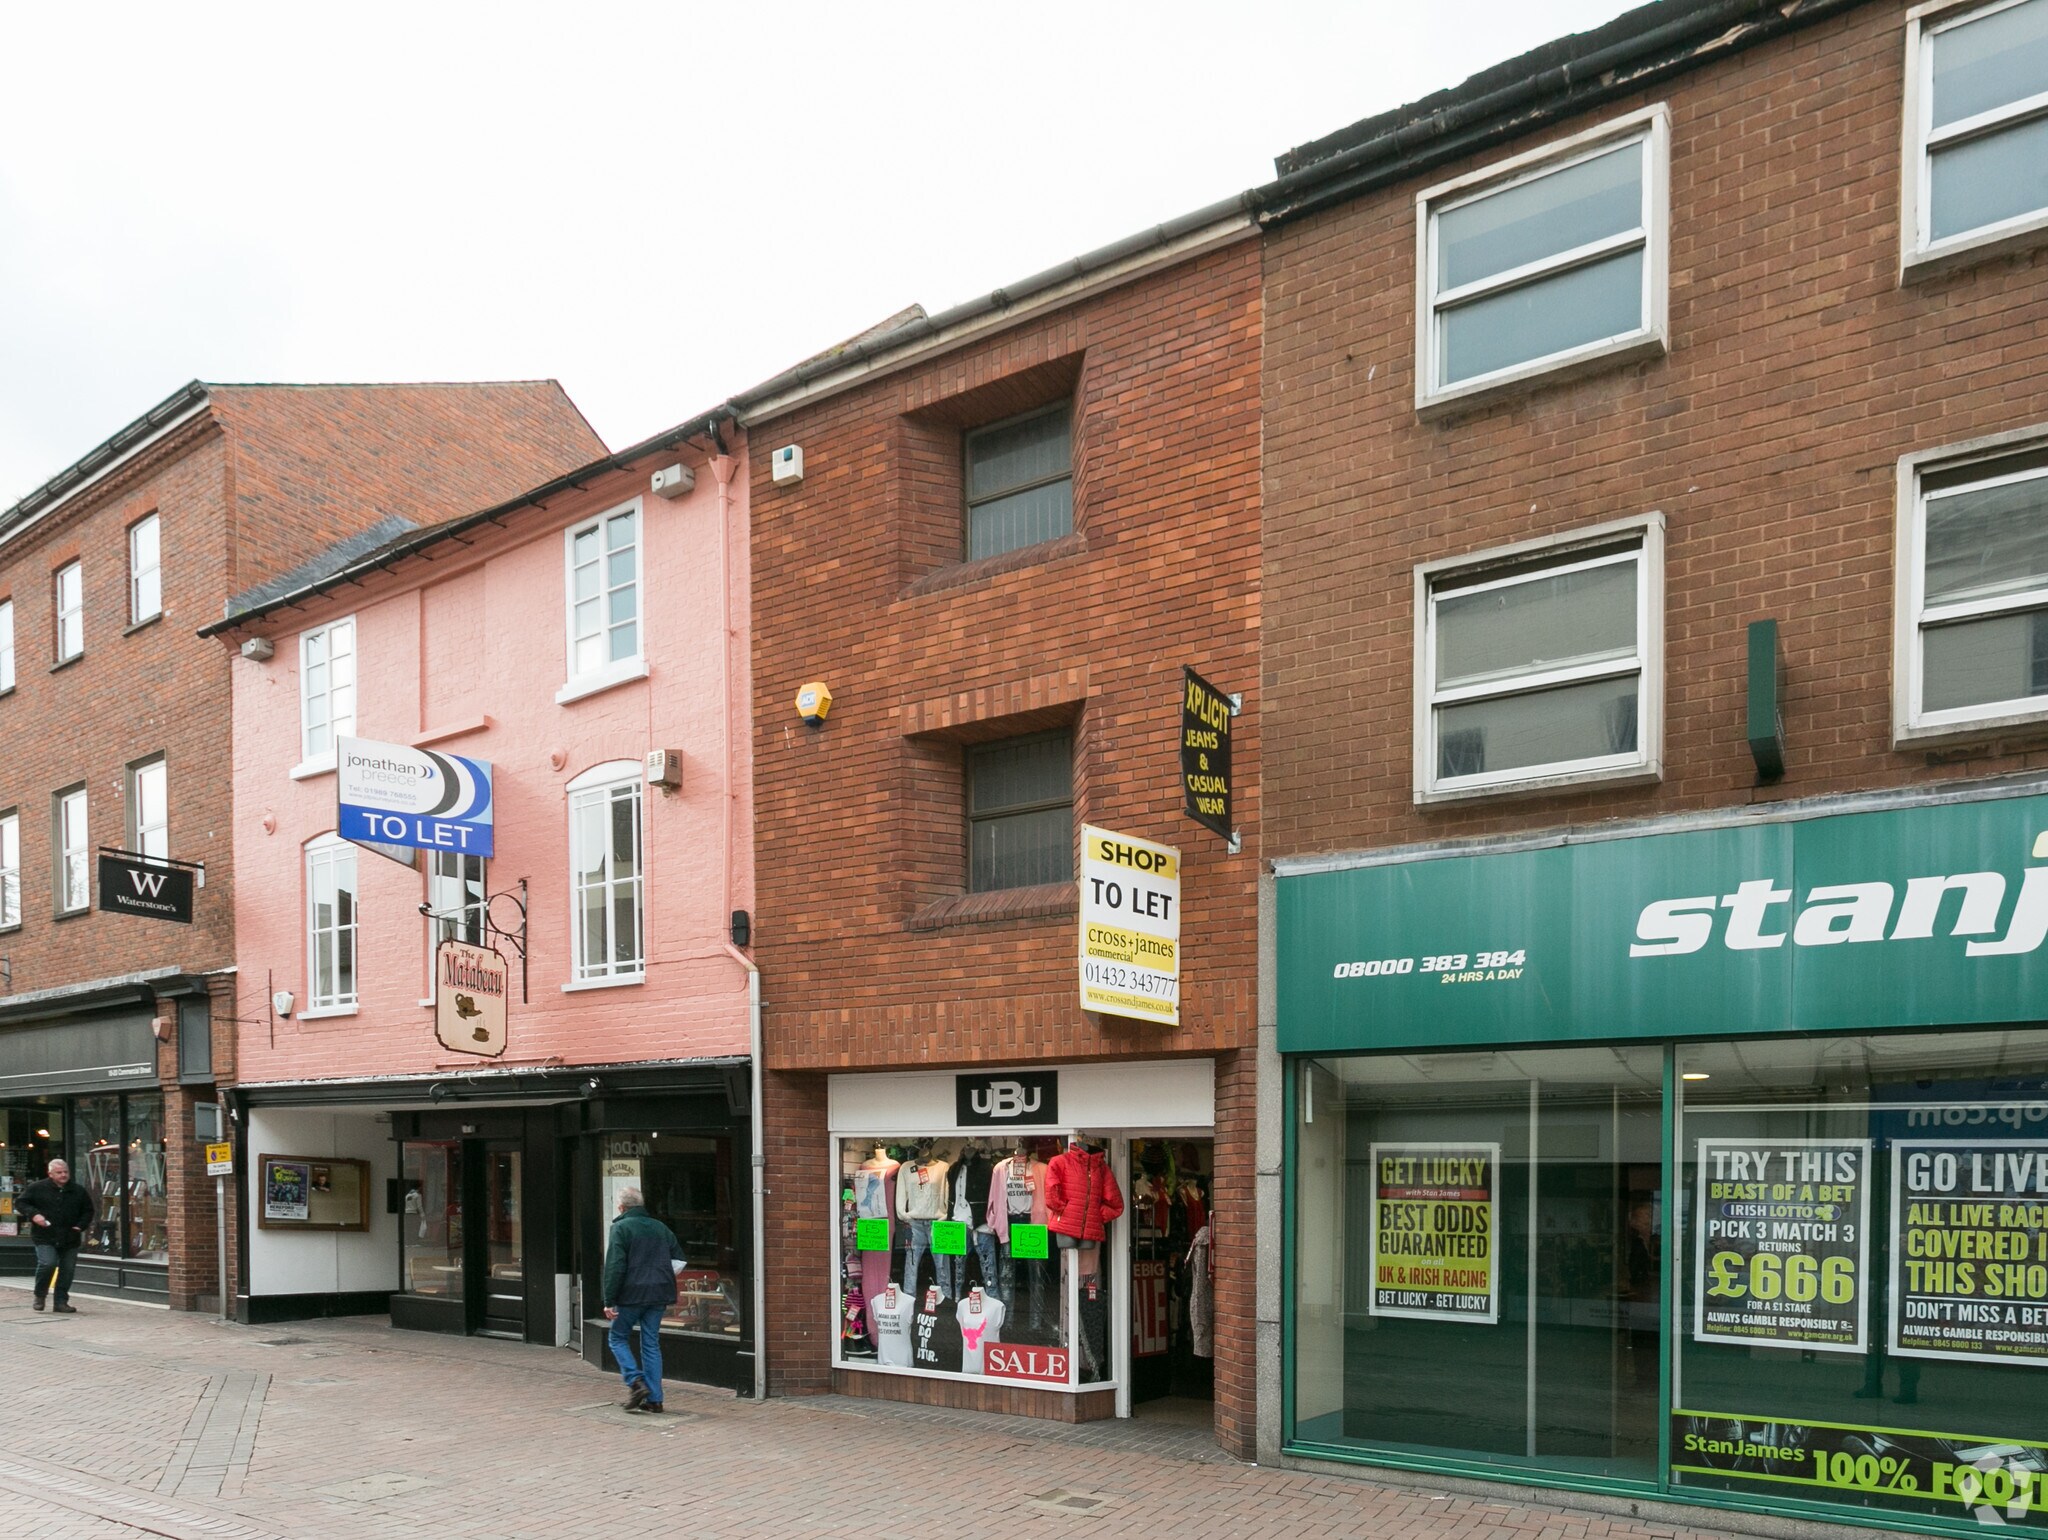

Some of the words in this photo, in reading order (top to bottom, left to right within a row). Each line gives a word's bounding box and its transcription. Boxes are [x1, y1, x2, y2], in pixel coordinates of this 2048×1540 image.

[1186, 679, 1229, 735] XPLICIT
[1185, 729, 1218, 750] JEANS
[347, 752, 416, 775] jonathan
[1199, 753, 1209, 771] &
[361, 769, 417, 787] preece
[1187, 774, 1228, 794] CASUAL
[1196, 797, 1225, 815] WEAR
[361, 812, 407, 839] TO
[417, 820, 473, 848] LET
[1101, 840, 1167, 873] SHOP
[127, 869, 168, 898] W
[116, 895, 177, 912] Waterstone's
[1091, 877, 1122, 909] TO
[1132, 887, 1172, 920] LET
[460, 949, 475, 960] The
[1088, 947, 1133, 963] commercial
[1333, 958, 1414, 978] 08000
[1419, 954, 1468, 972] 383
[1473, 950, 1526, 968] 384
[443, 952, 503, 998] Matabeau
[1085, 962, 1126, 988] 01432
[1129, 970, 1176, 997] 343777
[1441, 973, 1456, 984] 24
[1458, 971, 1484, 982] HRS
[1485, 971, 1495, 981] A
[1497, 969, 1523, 980] DAY
[1087, 989, 1174, 1014] www.crossandjames.co.uk
[970, 1081, 1042, 1117] UBU
[1381, 1157, 1417, 1185] GET
[1422, 1157, 1487, 1186] LUCKY
[1711, 1151, 1771, 1181] TRY
[1780, 1152, 1856, 1183] THIS
[1908, 1153, 1957, 1192] GO
[1972, 1153, 2048, 1193] LIVE
[1422, 1189, 1438, 1197] Stan
[1711, 1183, 1768, 1200] BEAST
[1772, 1183, 1796, 1200] OF
[1800, 1185, 1814, 1201] A
[1819, 1185, 1855, 1202] BET
[1380, 1203, 1428, 1231] BEST
[1434, 1204, 1488, 1234] ODDS
[1730, 1204, 1767, 1217] IRISH
[1769, 1205, 1813, 1218] LOTTO
[1907, 1203, 1945, 1225] ALL
[1951, 1204, 1994, 1226] LIVE
[1020, 1230, 1042, 1248] £5
[1710, 1220, 1750, 1239] PICK
[1756, 1221, 1767, 1240] 3
[1773, 1222, 1837, 1242] MATCH
[1843, 1224, 1855, 1242] 3
[1379, 1232, 1488, 1258] GUARANTEED
[1758, 1241, 1802, 1253] RETURNS
[1908, 1228, 2029, 1261] COVERED
[1433, 1258, 1444, 1266] all
[1379, 1266, 1394, 1283] UK
[1398, 1267, 1406, 1284] &
[1409, 1268, 1440, 1286] IRISH
[1443, 1270, 1487, 1288] RACING
[1707, 1251, 1855, 1304] £666
[1905, 1261, 1975, 1295] THIS
[1984, 1263, 2047, 1298] SHO
[1378, 1291, 1396, 1304] BET
[1398, 1292, 1428, 1306] LUCKY
[1436, 1294, 1454, 1308] GET
[1456, 1295, 1487, 1310] LUCKY
[1747, 1300, 1763, 1310] FOR
[1764, 1301, 1771, 1311] A
[1772, 1302, 1783, 1312] £1
[1784, 1303, 1812, 1314] STAKE
[1133, 1278, 1167, 1353] ALE
[1707, 1312, 1740, 1324] ALWAYS
[1742, 1314, 1777, 1327] GAMBLE
[1779, 1316, 1838, 1330] RESPONSIBLY
[1906, 1301, 1953, 1320] DON'T
[1958, 1304, 2000, 1323] MISS
[2004, 1306, 2017, 1324] A
[918, 1325, 931, 1338] DO
[1787, 1330, 1853, 1341] www.gamcare.org.uk
[1903, 1325, 1941, 1337] ALWAYS
[1943, 1327, 1983, 1340] GAMBLE
[1985, 1329, 2048, 1344] RESPONSIBL
[1902, 1338, 1931, 1347] Helpline:
[1933, 1339, 1950, 1347] 0845
[1951, 1341, 1969, 1349] 6000
[1971, 1342, 1983, 1350] 133
[989, 1348, 1066, 1378] SALE
[1684, 1433, 1805, 1462] StanJames
[1813, 1450, 1918, 1492] 100%
